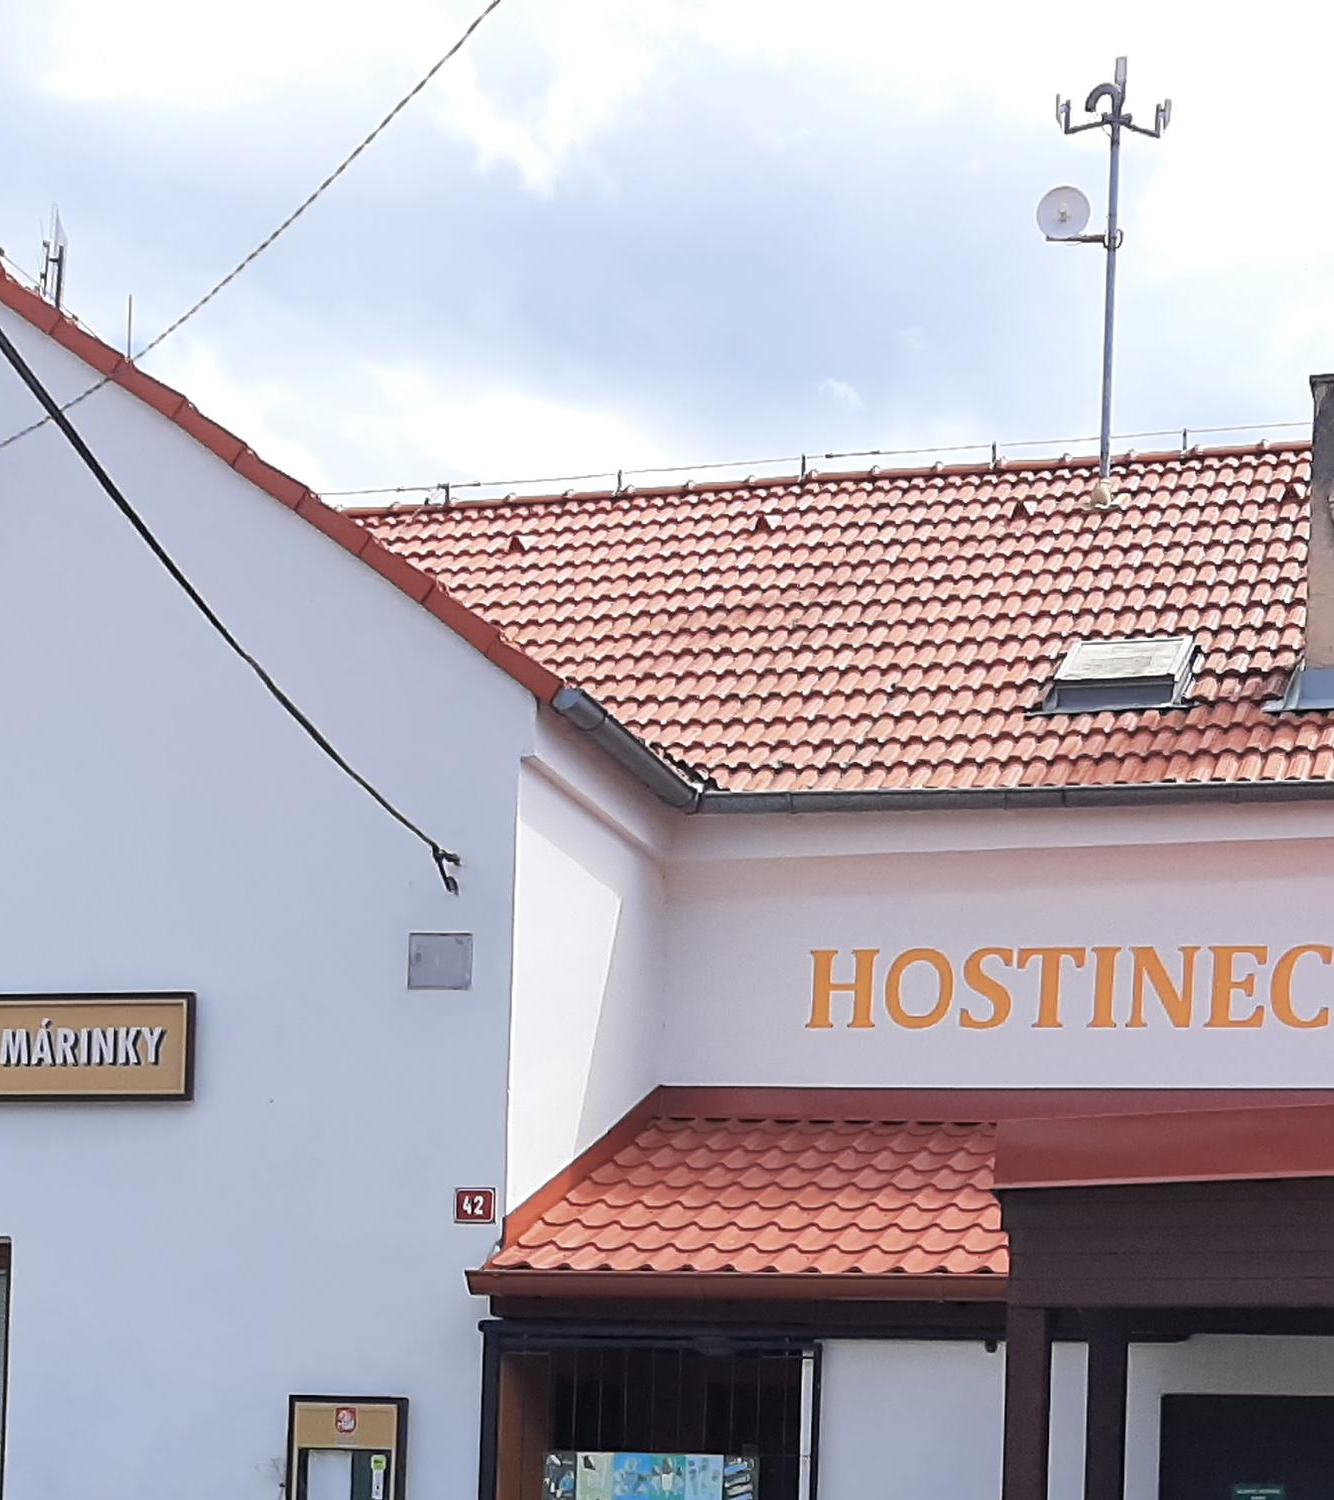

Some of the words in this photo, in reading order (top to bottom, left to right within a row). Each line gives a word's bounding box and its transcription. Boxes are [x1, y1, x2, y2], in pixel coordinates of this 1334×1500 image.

[805, 943, 1334, 1029] HOSTINEC
[0, 1018, 168, 1067] MÁRINKY
[462, 1195, 484, 1216] 42
